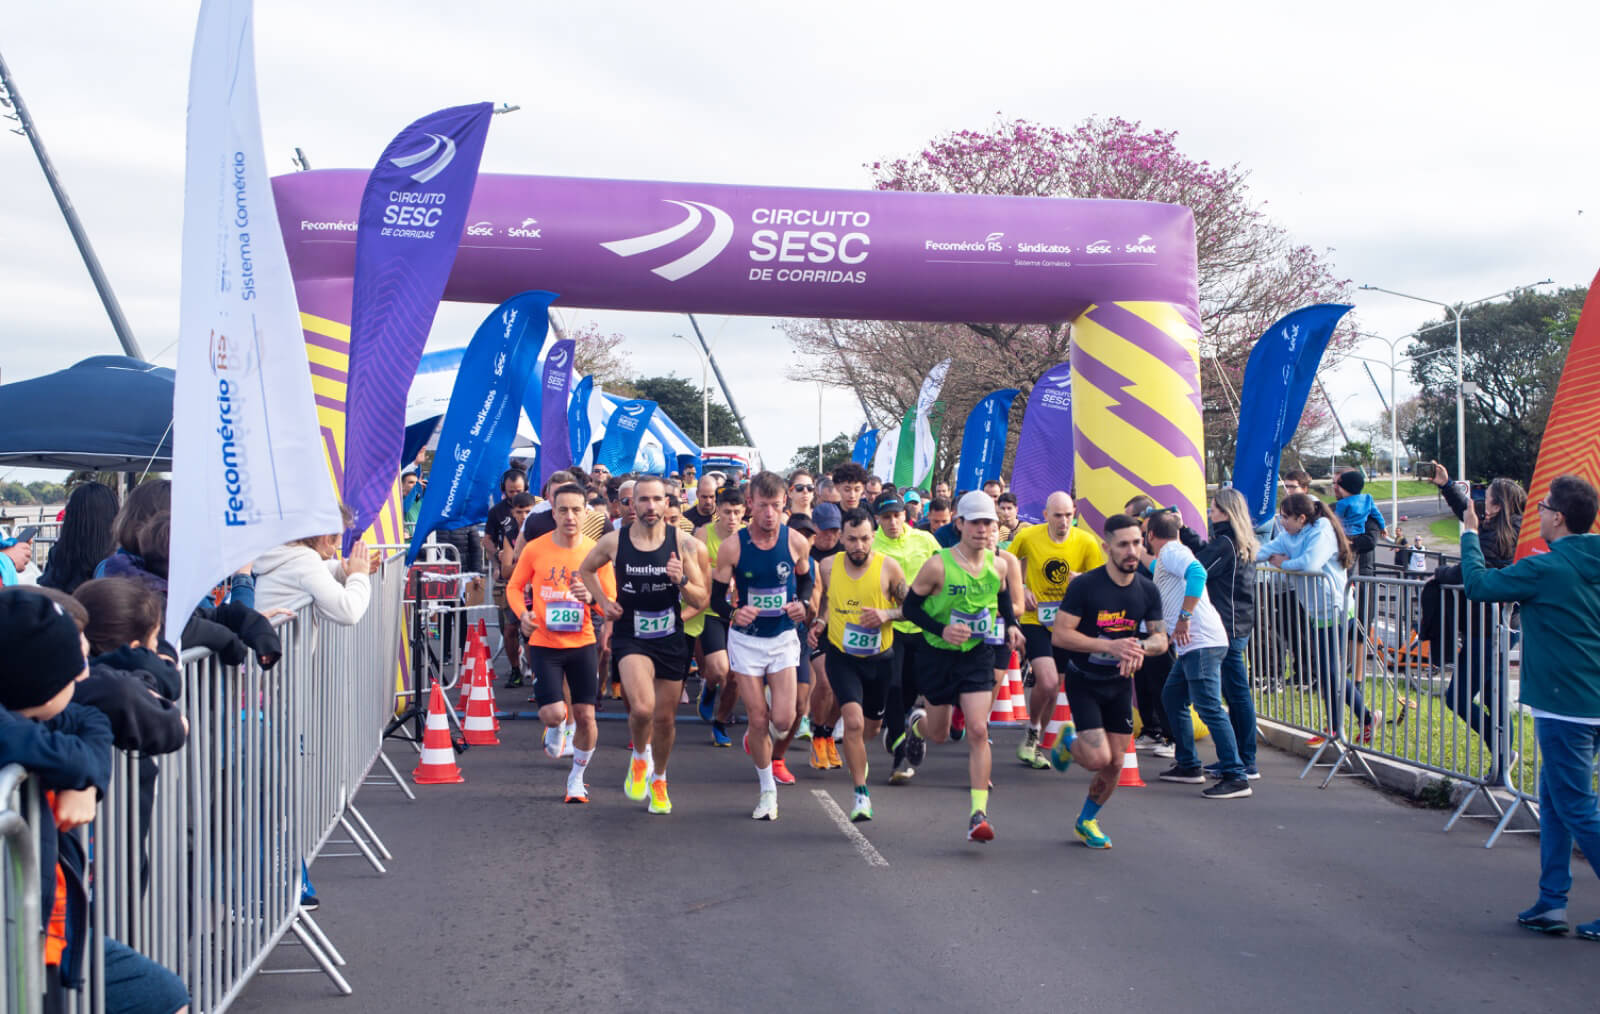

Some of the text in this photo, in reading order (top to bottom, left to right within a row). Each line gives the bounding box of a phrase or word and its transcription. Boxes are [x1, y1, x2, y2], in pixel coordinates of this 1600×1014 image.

[389, 190, 446, 205] CIRCUITO
[383, 204, 442, 227] SESC
[751, 208, 870, 228] CIRCUITO
[232, 151, 257, 301] Sistema Comércio
[381, 227, 435, 239] DE CORRIDAS
[749, 229, 871, 265] SESC
[925, 239, 985, 251] Fecomércio
[988, 241, 1003, 252] RS
[1017, 242, 1071, 254] Sindicatos
[749, 268, 867, 284] DE CORRIDAS
[1041, 393, 1071, 406] SESC
[220, 378, 247, 526] Fecomércio
[442, 462, 465, 518] Fecomércio
[469, 388, 497, 437] Sindicatos
[625, 563, 667, 576] boutiqu
[752, 595, 783, 608] 259
[551, 609, 580, 623] 289
[640, 615, 670, 631] 217
[847, 632, 878, 648] 281
